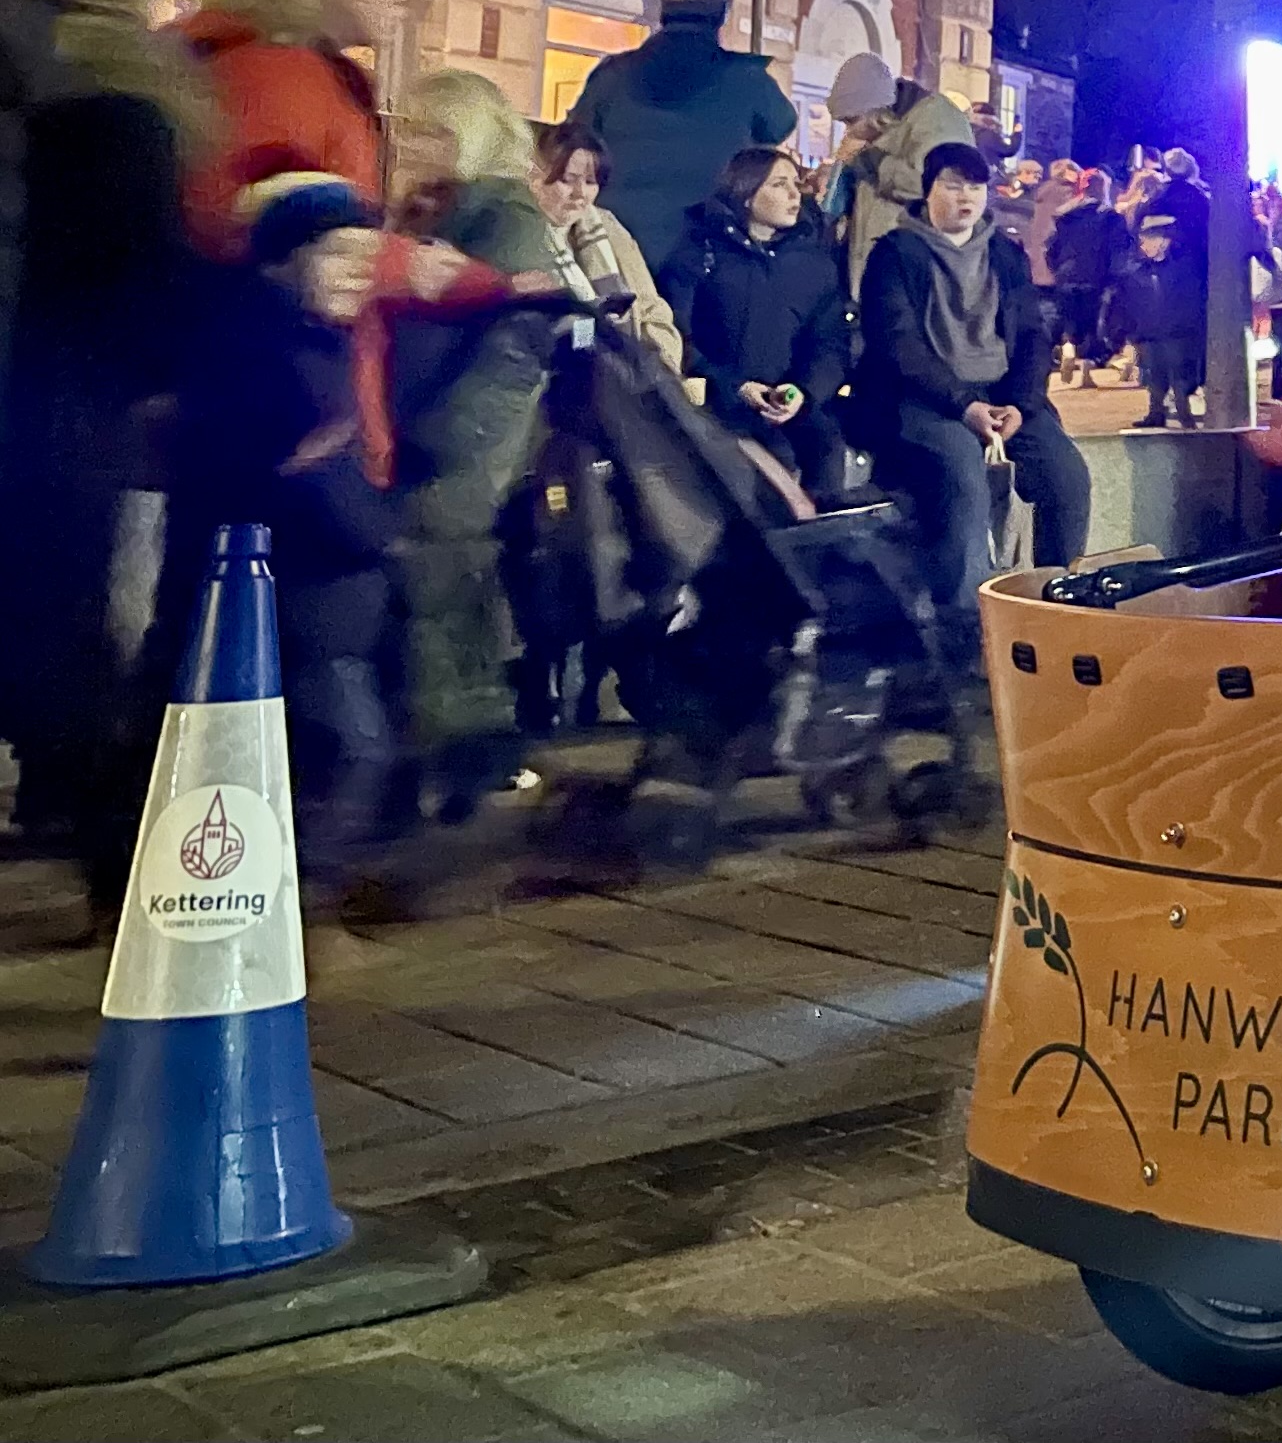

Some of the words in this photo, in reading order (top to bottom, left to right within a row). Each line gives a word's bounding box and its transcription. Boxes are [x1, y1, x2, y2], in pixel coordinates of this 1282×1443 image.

[148, 888, 266, 916] Kettering
[162, 918, 195, 929] TOWN
[198, 916, 247, 927] COUNCIL
